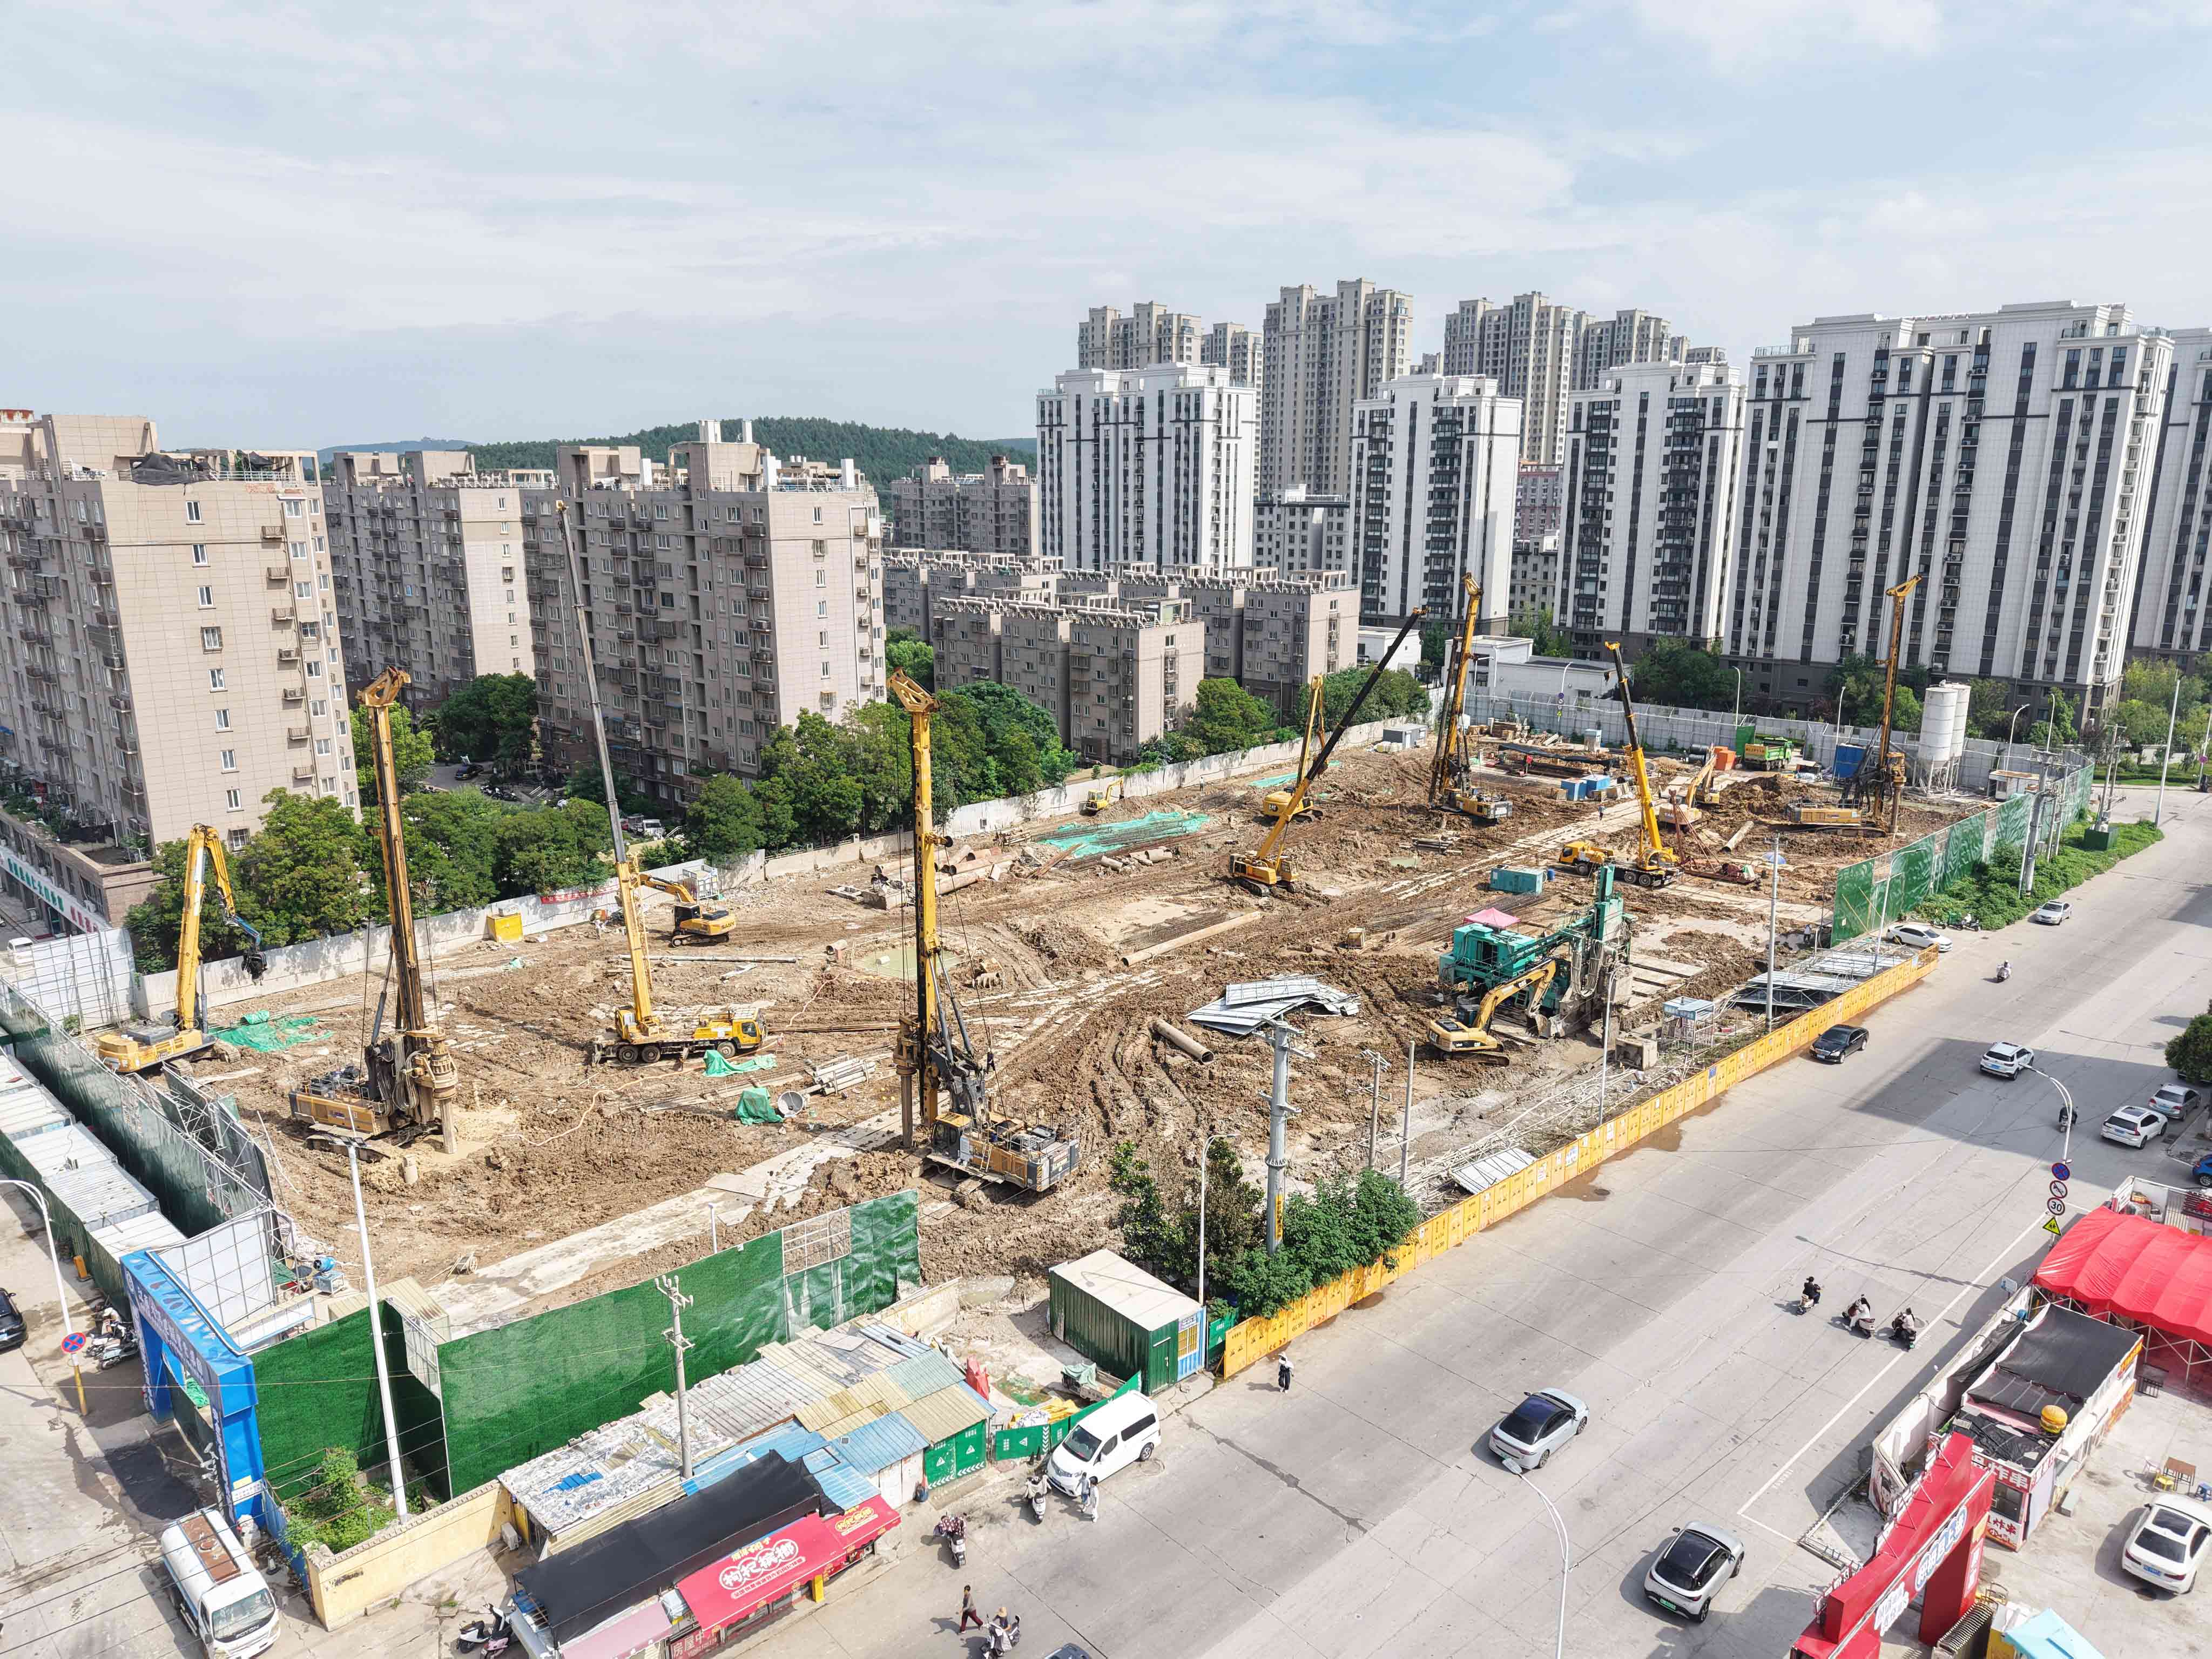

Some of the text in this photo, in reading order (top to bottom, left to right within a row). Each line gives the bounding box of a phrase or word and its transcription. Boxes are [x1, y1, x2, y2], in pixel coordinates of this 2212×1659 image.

[721, 921, 735, 930] SANY
[1519, 980, 1527, 989] CAT
[1429, 1030, 1438, 1043] CAT
[2051, 1201, 2062, 1212] 30
[723, 1541, 795, 1587] 枸杞槟榔
[235, 1624, 259, 1638] FOTON
